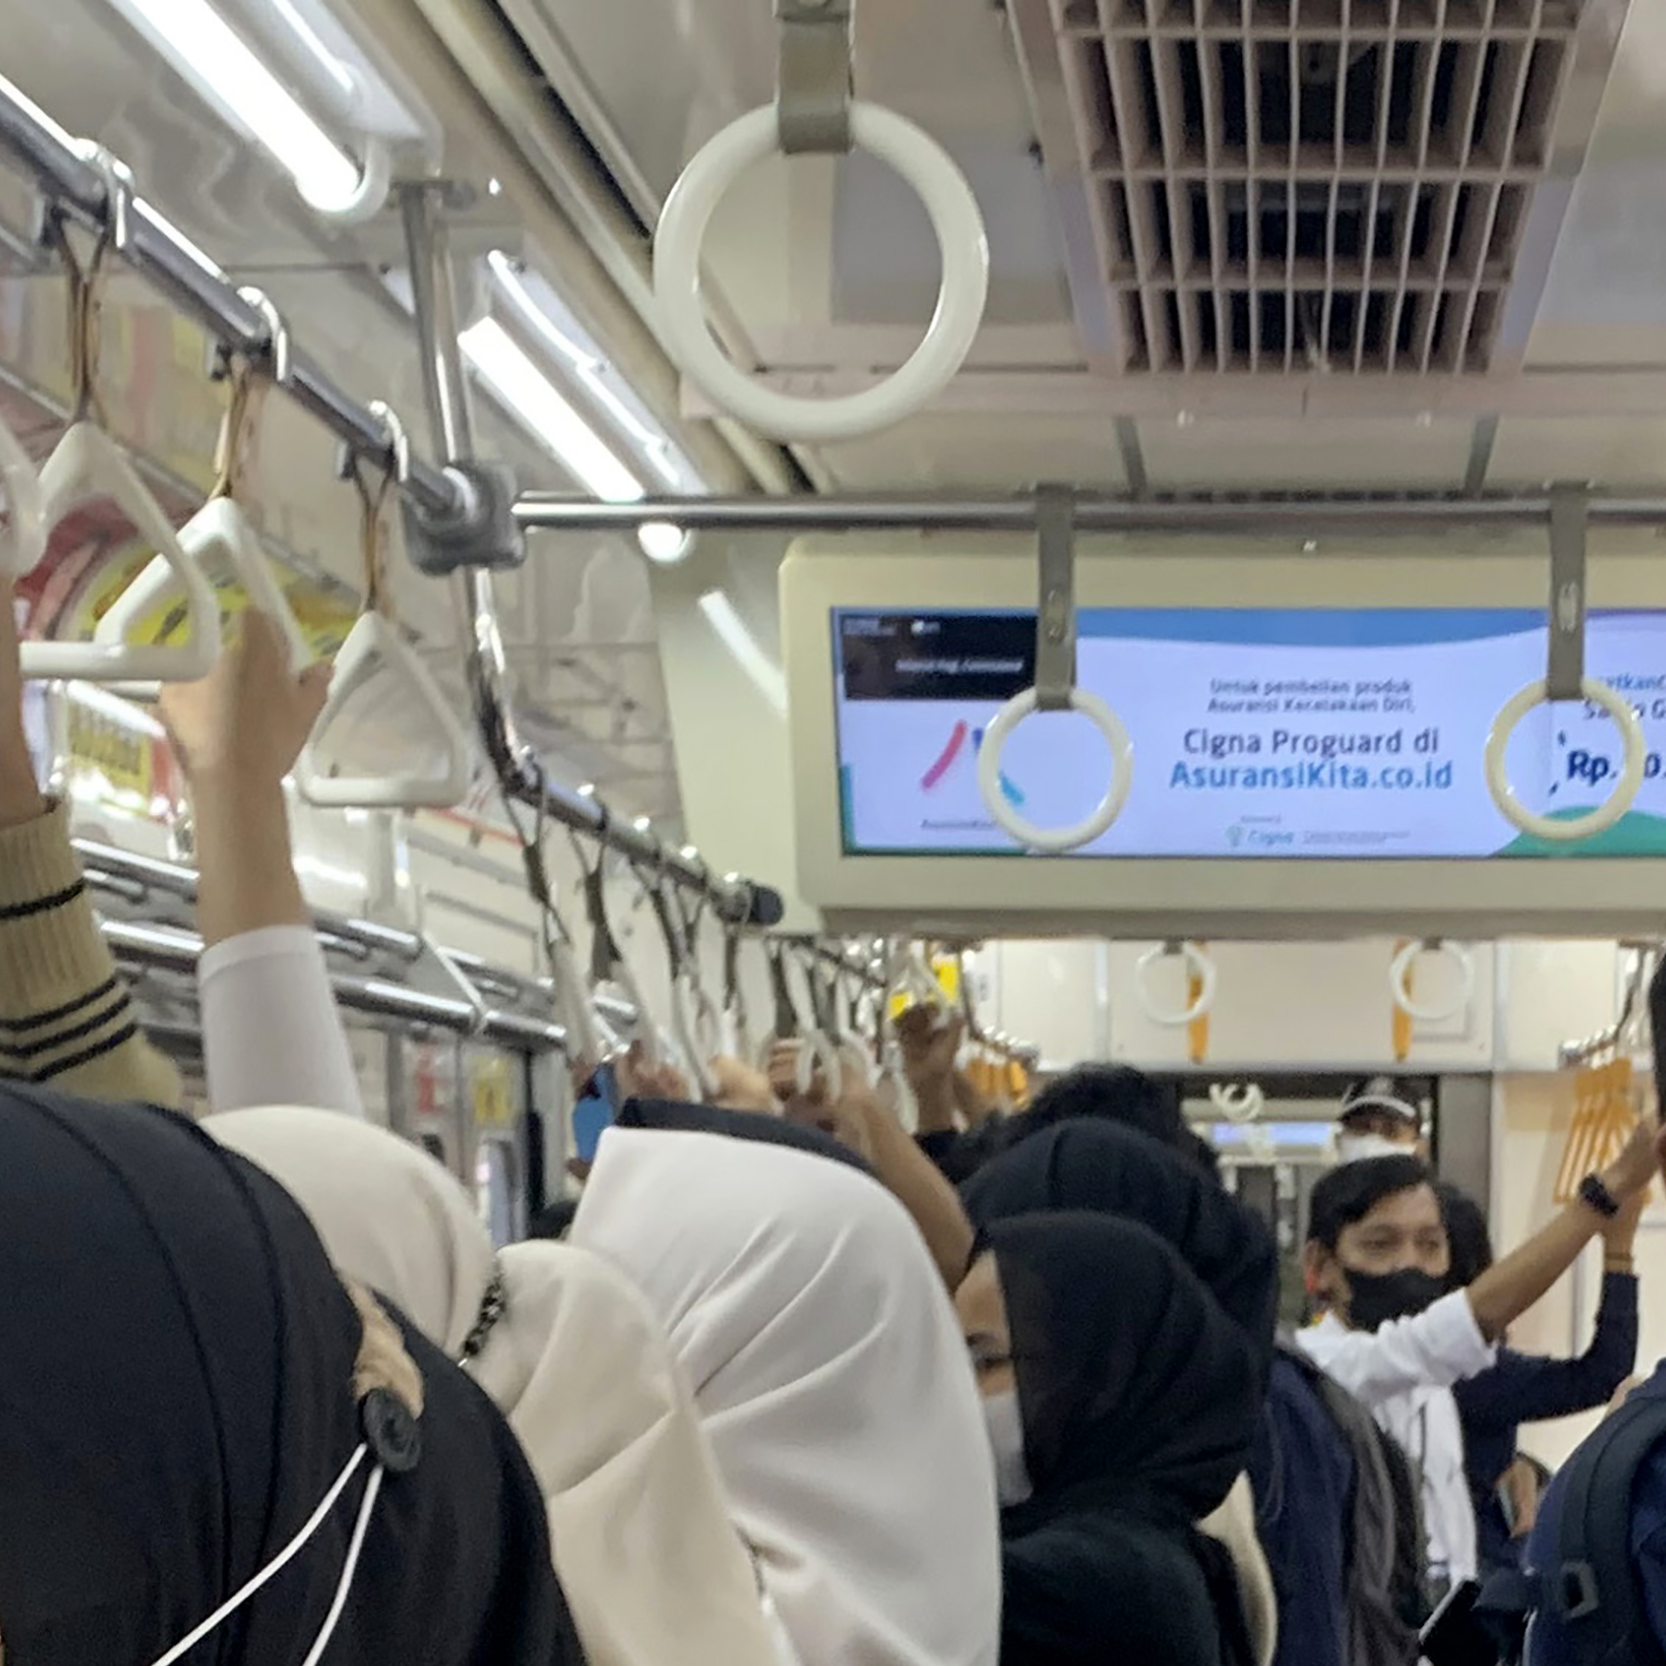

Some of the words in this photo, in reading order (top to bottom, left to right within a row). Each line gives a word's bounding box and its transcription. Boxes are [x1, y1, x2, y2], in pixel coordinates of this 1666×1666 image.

[1209, 679, 1259, 695] Untuk
[1263, 678, 1350, 697] pembelian
[1354, 678, 1412, 697] produk
[1206, 697, 1279, 713] Asuransi
[1183, 727, 1262, 759] Cigna
[1271, 727, 1403, 760] Proguard
[1413, 727, 1440, 753] di
[1169, 759, 1454, 790] AsuransiKita.co.id
